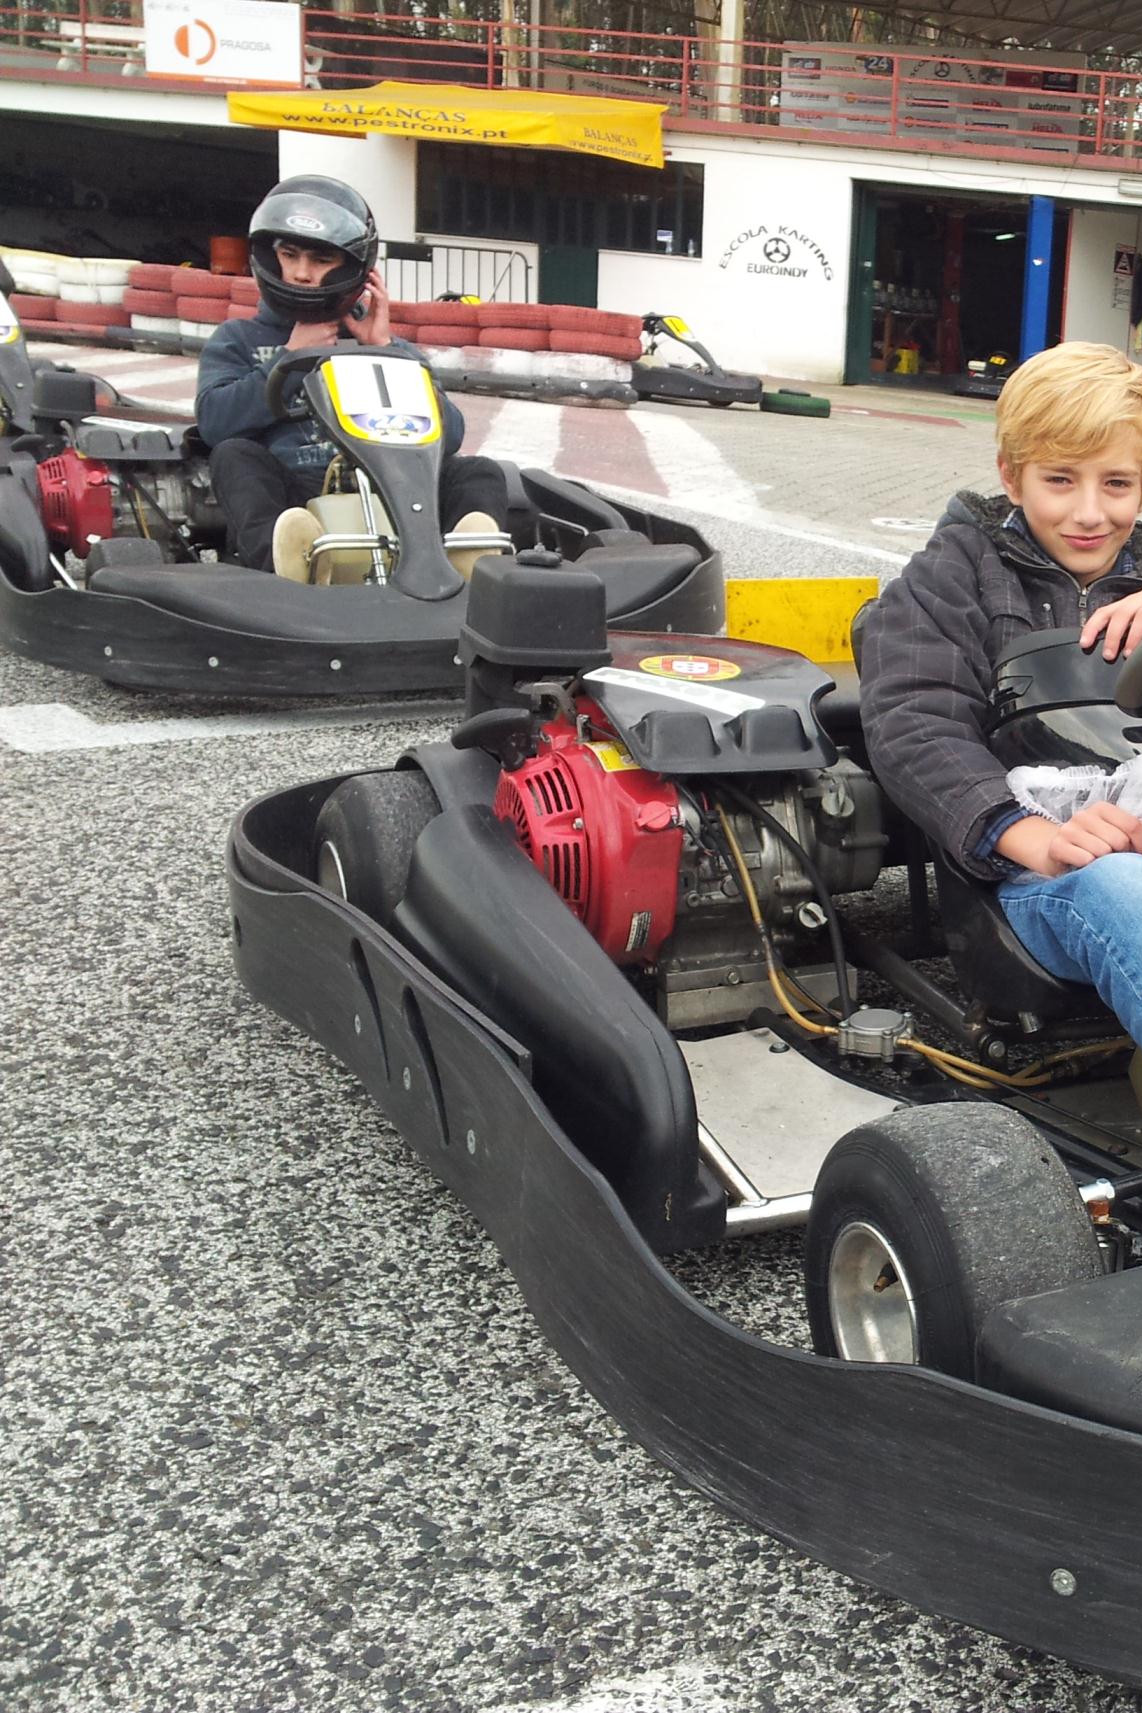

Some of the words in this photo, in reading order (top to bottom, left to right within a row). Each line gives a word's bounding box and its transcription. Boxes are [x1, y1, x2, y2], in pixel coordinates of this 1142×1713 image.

[219, 39, 272, 52] PRAGOSA
[322, 101, 467, 124] BALANÇAS
[282, 113, 509, 140] www.pestronix.pt
[719, 225, 768, 269] ESCOLA
[778, 225, 834, 281] KARTING
[746, 263, 808, 278] EUROINDY
[372, 363, 392, 408] 1
